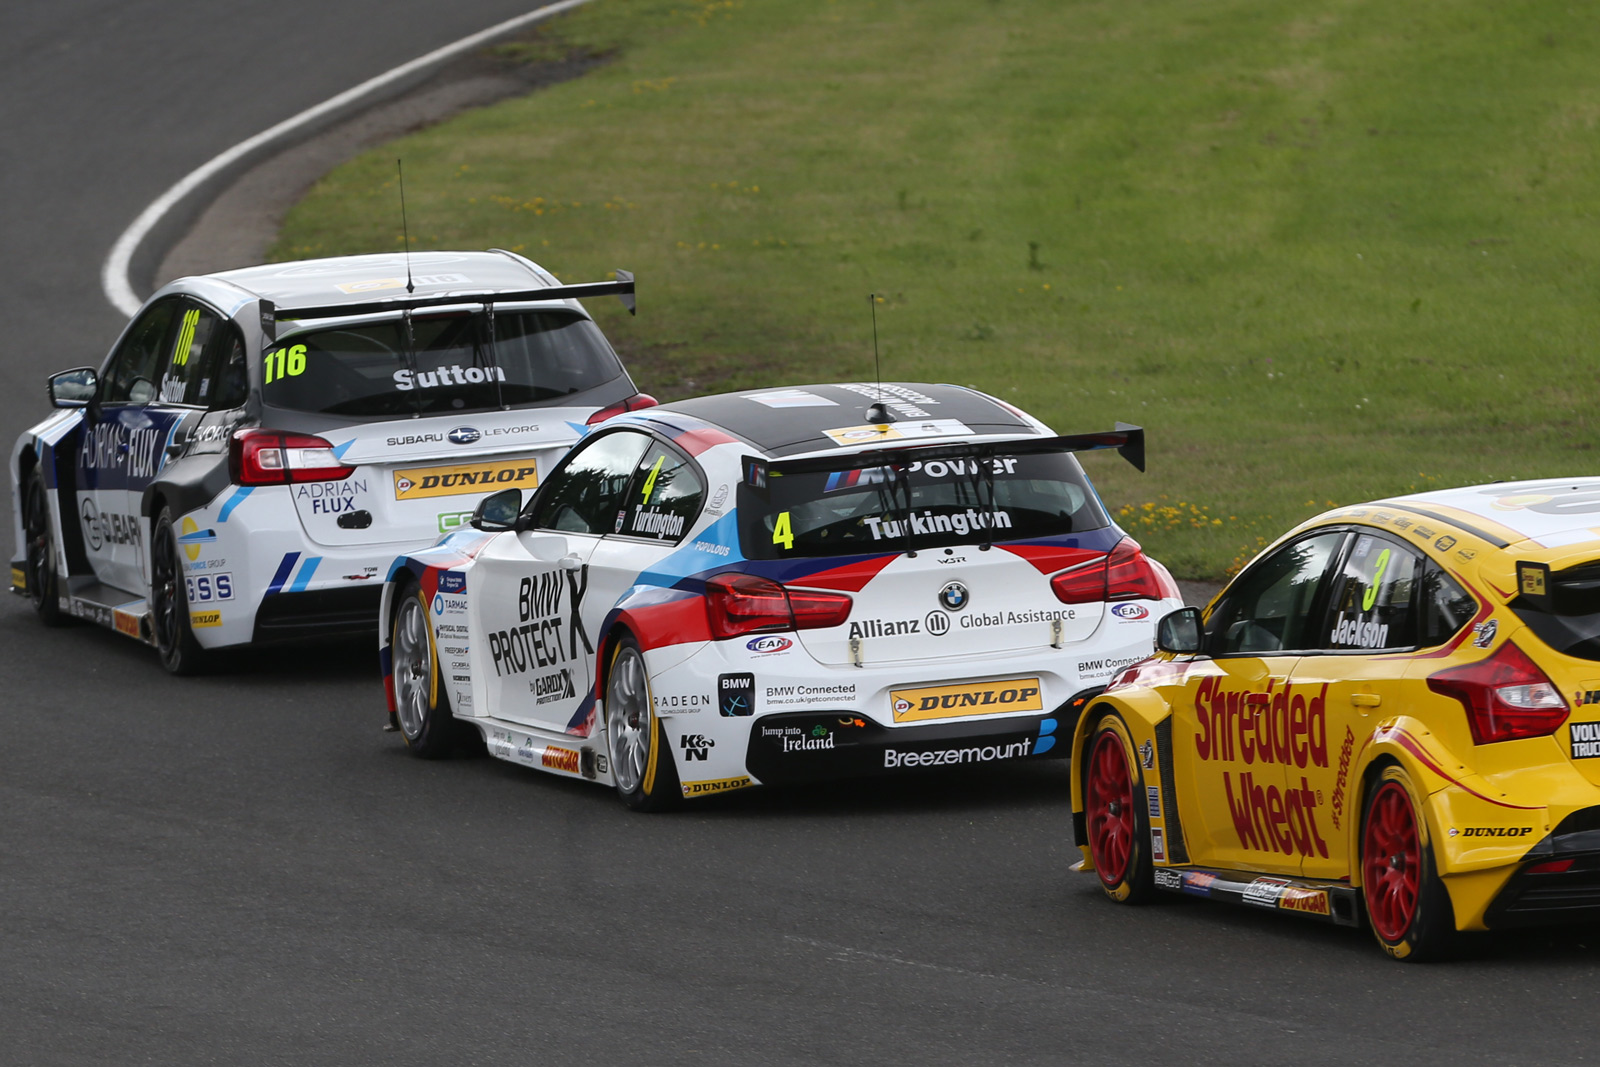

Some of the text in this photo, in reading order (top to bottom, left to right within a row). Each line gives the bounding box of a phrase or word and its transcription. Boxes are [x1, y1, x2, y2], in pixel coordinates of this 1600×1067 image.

[173, 309, 200, 366] 116
[264, 344, 307, 385] 116
[160, 372, 186, 403] Sutton
[392, 364, 506, 391] Sutton
[387, 424, 540, 446] SUBARU LEVORG
[80, 422, 160, 478] ADRIAN FLUX
[297, 479, 368, 500] ADRIAN
[418, 467, 535, 490] DUNLOP
[641, 456, 665, 504] 4
[313, 496, 357, 515] FLUX
[632, 504, 685, 539] Turkington
[772, 511, 795, 549] 4
[864, 508, 1012, 541] Turkington
[695, 541, 730, 556] POPULOUS
[937, 557, 967, 565] WSR
[362, 566, 378, 574] TOW
[1362, 549, 1390, 611] 3
[445, 600, 468, 610] TARMAC
[519, 569, 563, 622] BMW
[849, 607, 1077, 640] Allianz Global Assistance
[1331, 611, 1389, 648] Jackson
[488, 617, 566, 677] PROTECT
[1078, 654, 1150, 671] BMW Connect
[535, 673, 564, 697] GARDX
[722, 678, 750, 689] BMW
[766, 683, 857, 697] BMW Connected
[653, 694, 710, 707] RADEON
[766, 694, 857, 706] bmw.co.uk/getconnected
[918, 688, 1039, 711] DUNLOP
[761, 726, 801, 737] Jump into
[1195, 674, 1330, 769] Shredded
[783, 732, 836, 753] Ireland
[884, 738, 1032, 768] Breezemount
[541, 745, 580, 774] AUTOCAR
[692, 778, 751, 793] DUNLOP
[1223, 772, 1330, 860] Wheat
[1462, 826, 1533, 837] DUNLOP
[1281, 887, 1328, 915] AUTOCAR
